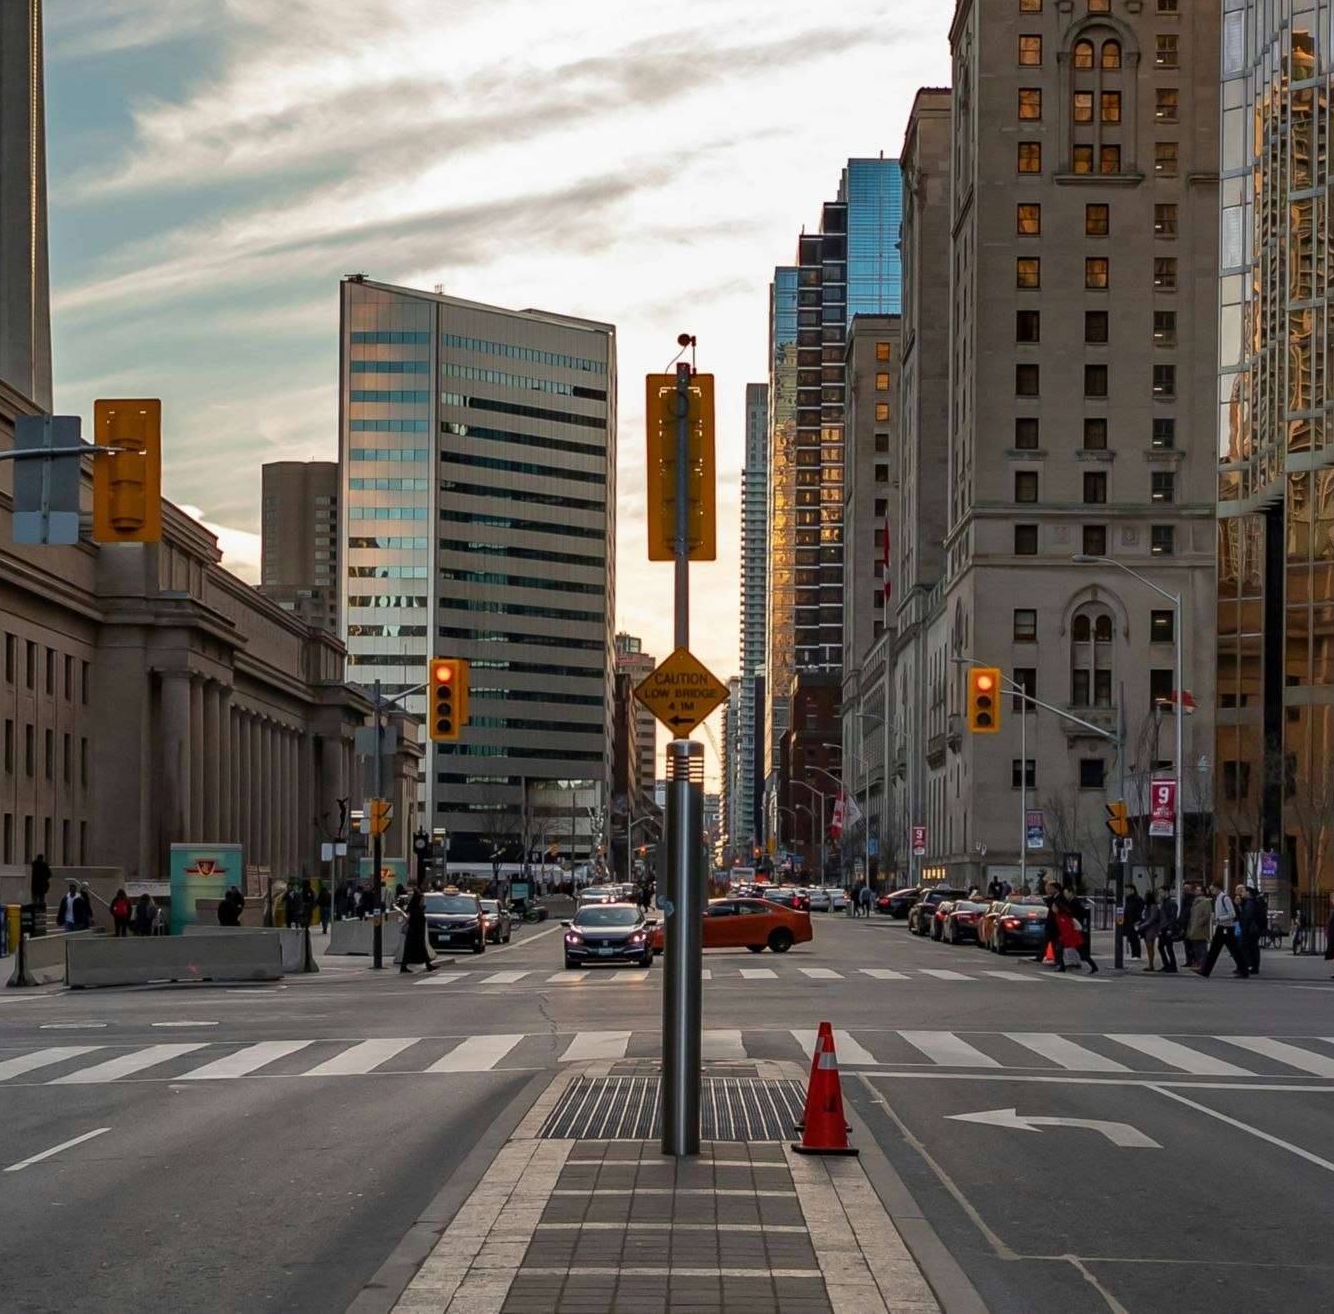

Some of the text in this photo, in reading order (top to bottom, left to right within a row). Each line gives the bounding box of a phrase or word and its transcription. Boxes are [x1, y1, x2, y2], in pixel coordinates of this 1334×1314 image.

[654, 672, 708, 686] CAUTION
[644, 689, 717, 699] LOW BRIDGE
[1158, 786, 1170, 805] 9
[915, 829, 924, 840] 9
